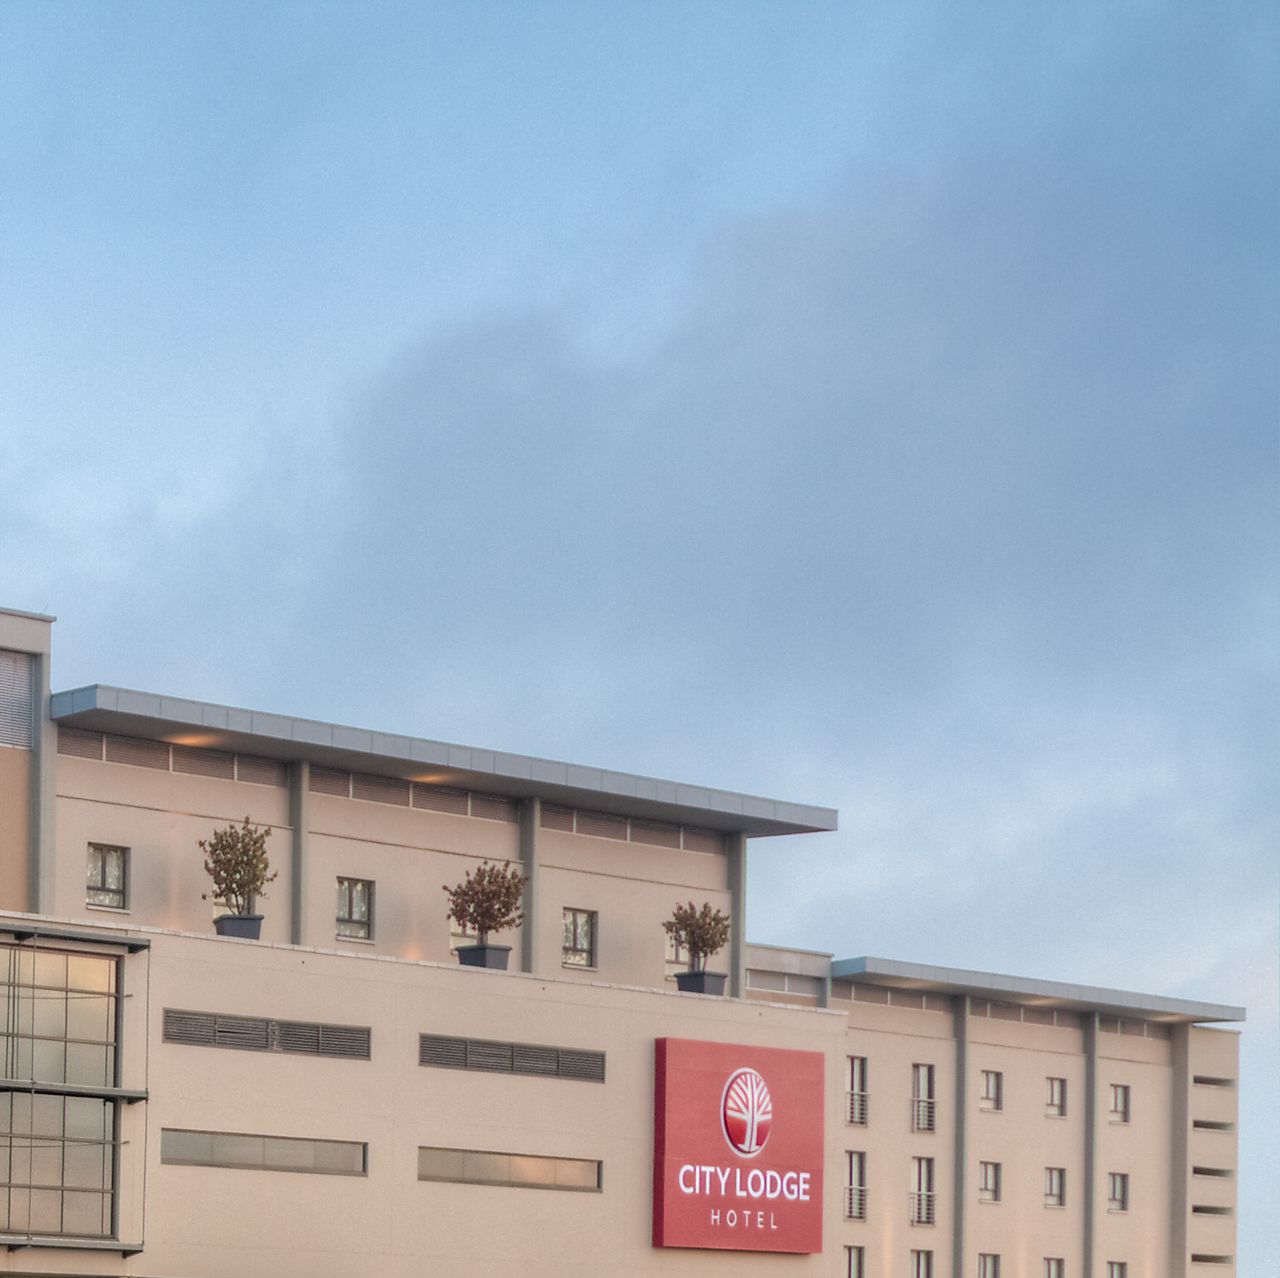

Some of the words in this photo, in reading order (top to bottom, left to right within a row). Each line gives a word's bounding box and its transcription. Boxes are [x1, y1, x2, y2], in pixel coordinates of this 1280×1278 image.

[678, 1164, 730, 1195] CITY
[735, 1167, 811, 1201] LODGE
[711, 1208, 778, 1229] HOTEL
